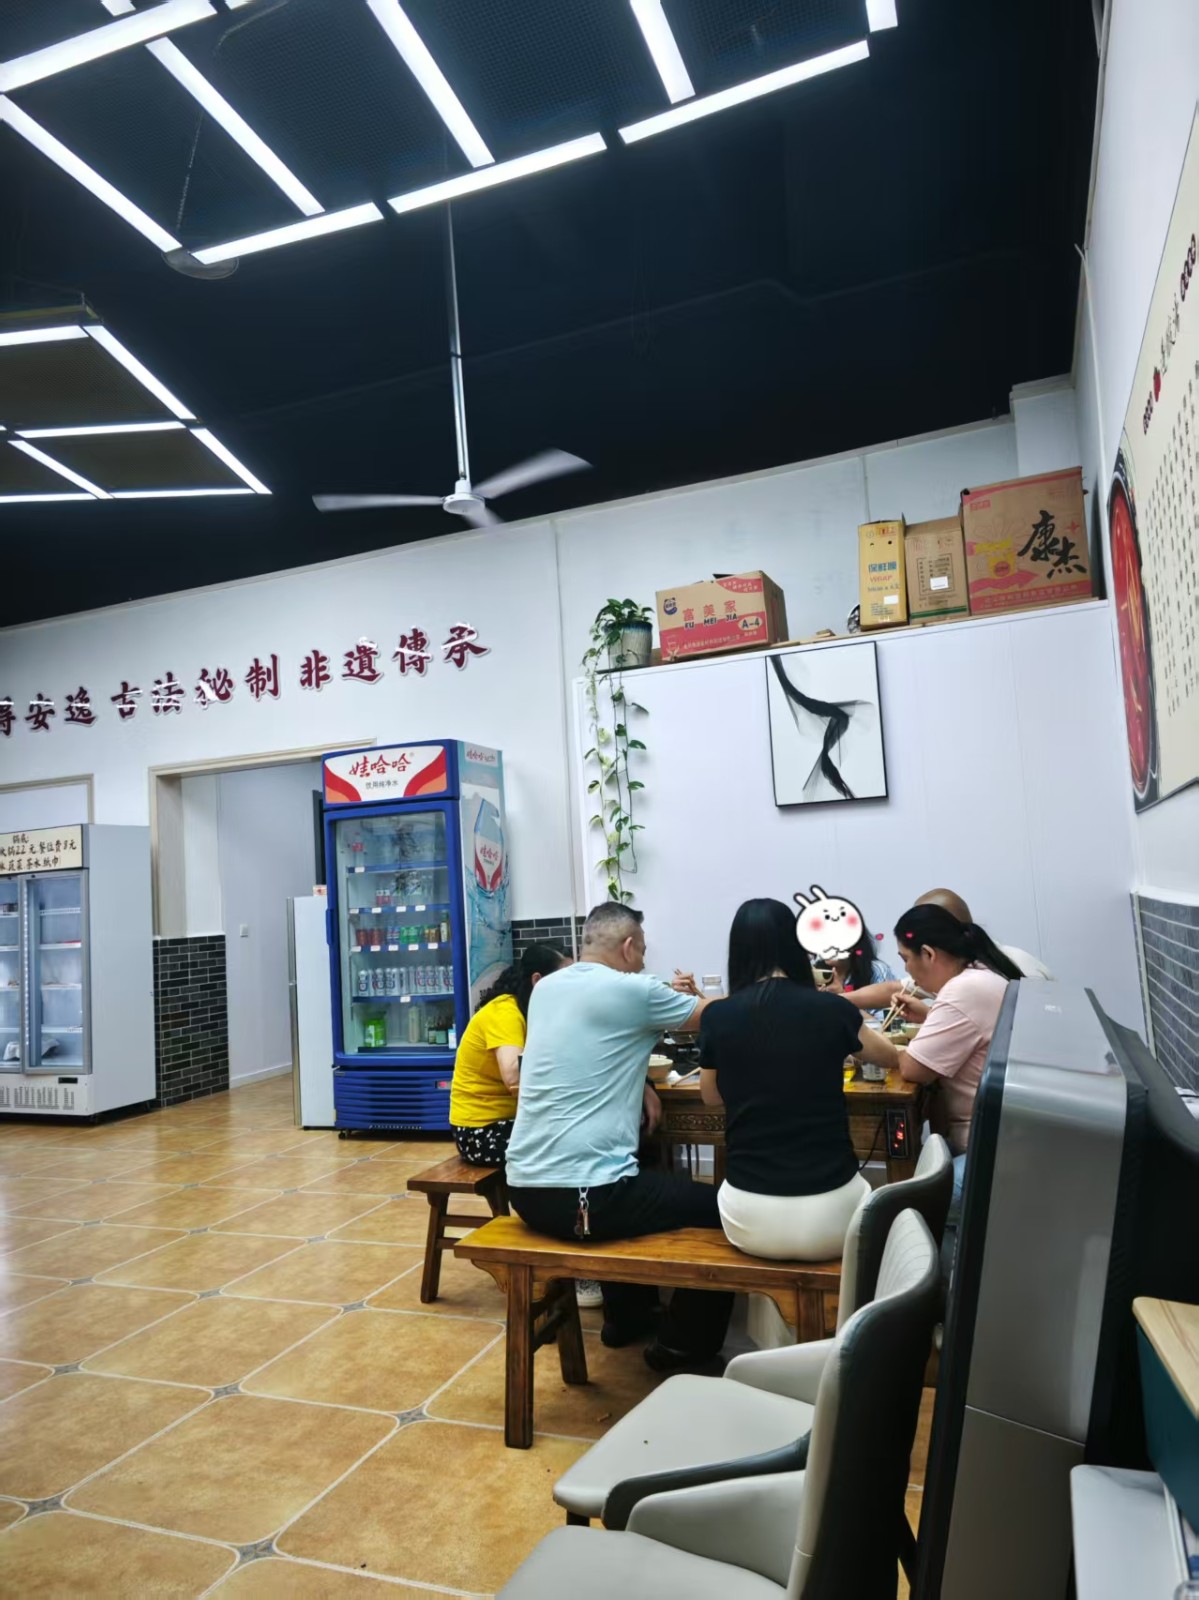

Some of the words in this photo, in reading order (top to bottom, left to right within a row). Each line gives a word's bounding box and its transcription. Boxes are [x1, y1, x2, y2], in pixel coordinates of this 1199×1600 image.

[682, 599, 737, 622] 富美家
[684, 620, 695, 629] FU
[703, 617, 717, 627] MEI
[725, 612, 738, 622] JIA
[741, 617, 760, 629] A-4
[349, 752, 412, 778] 娃哈哈
[365, 780, 399, 790] 饮用纯净水
